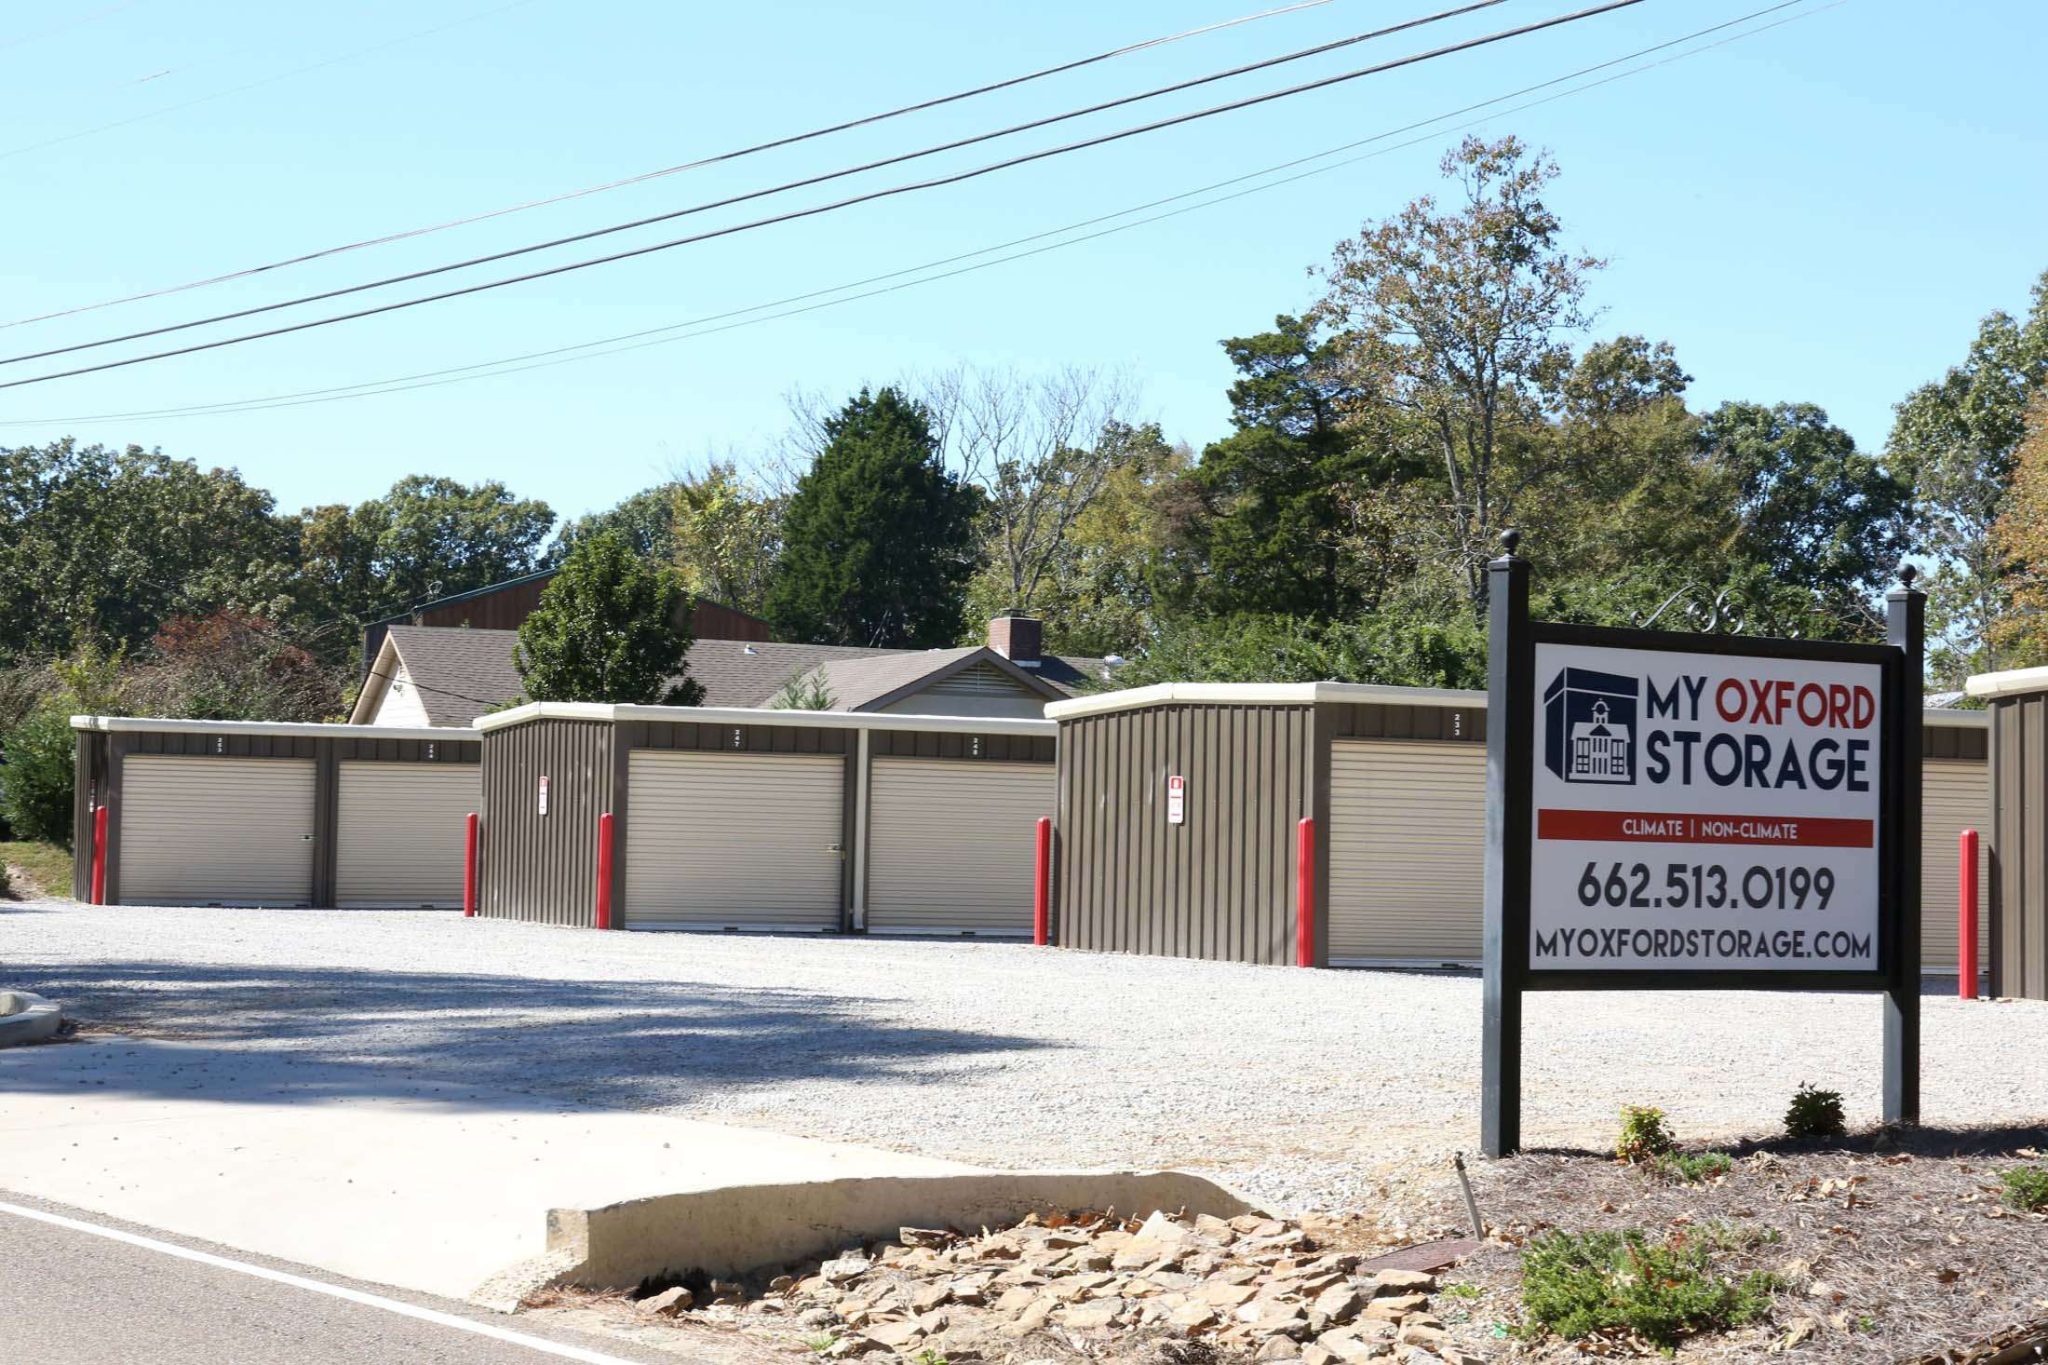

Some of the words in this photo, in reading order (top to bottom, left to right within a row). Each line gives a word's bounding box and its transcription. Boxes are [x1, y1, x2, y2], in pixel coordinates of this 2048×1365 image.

[1647, 675, 1708, 721] MY
[1715, 678, 1875, 729] OXFORD
[1646, 730, 1870, 792] STORAGE
[1622, 819, 1683, 836] CLIMATE
[1702, 821, 1798, 839] NON-CLIMATE
[1578, 862, 1835, 910] 662.513.0199
[1536, 928, 1871, 959] MYOXFORDSTORAGE.COM
